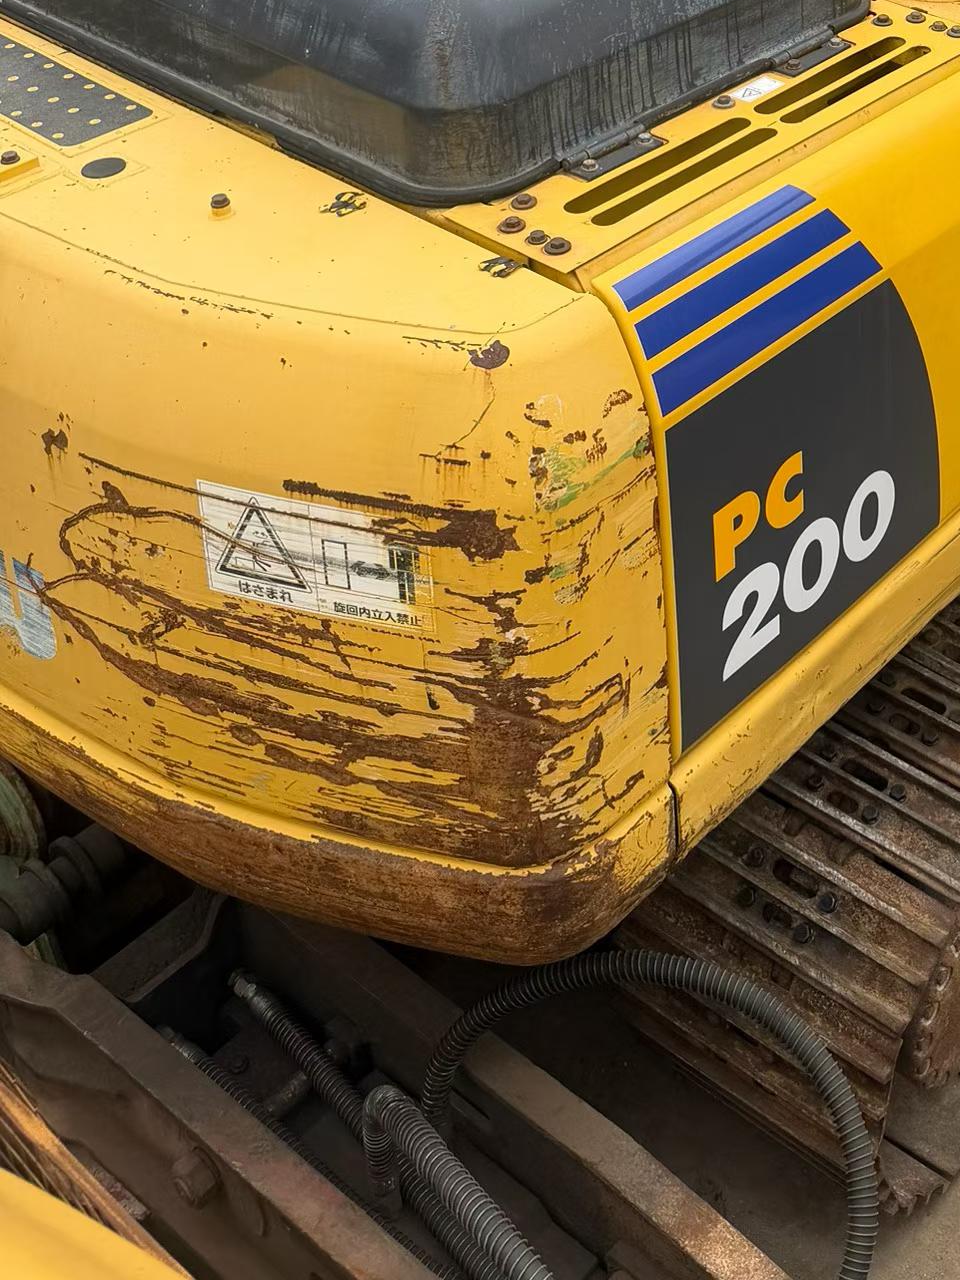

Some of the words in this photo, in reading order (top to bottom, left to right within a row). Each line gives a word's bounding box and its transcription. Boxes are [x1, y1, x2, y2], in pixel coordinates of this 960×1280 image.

[713, 450, 804, 583] PC
[238, 580, 293, 603] はさまれ
[333, 601, 422, 626] 旋回内立入禁止
[722, 469, 896, 682] 200
